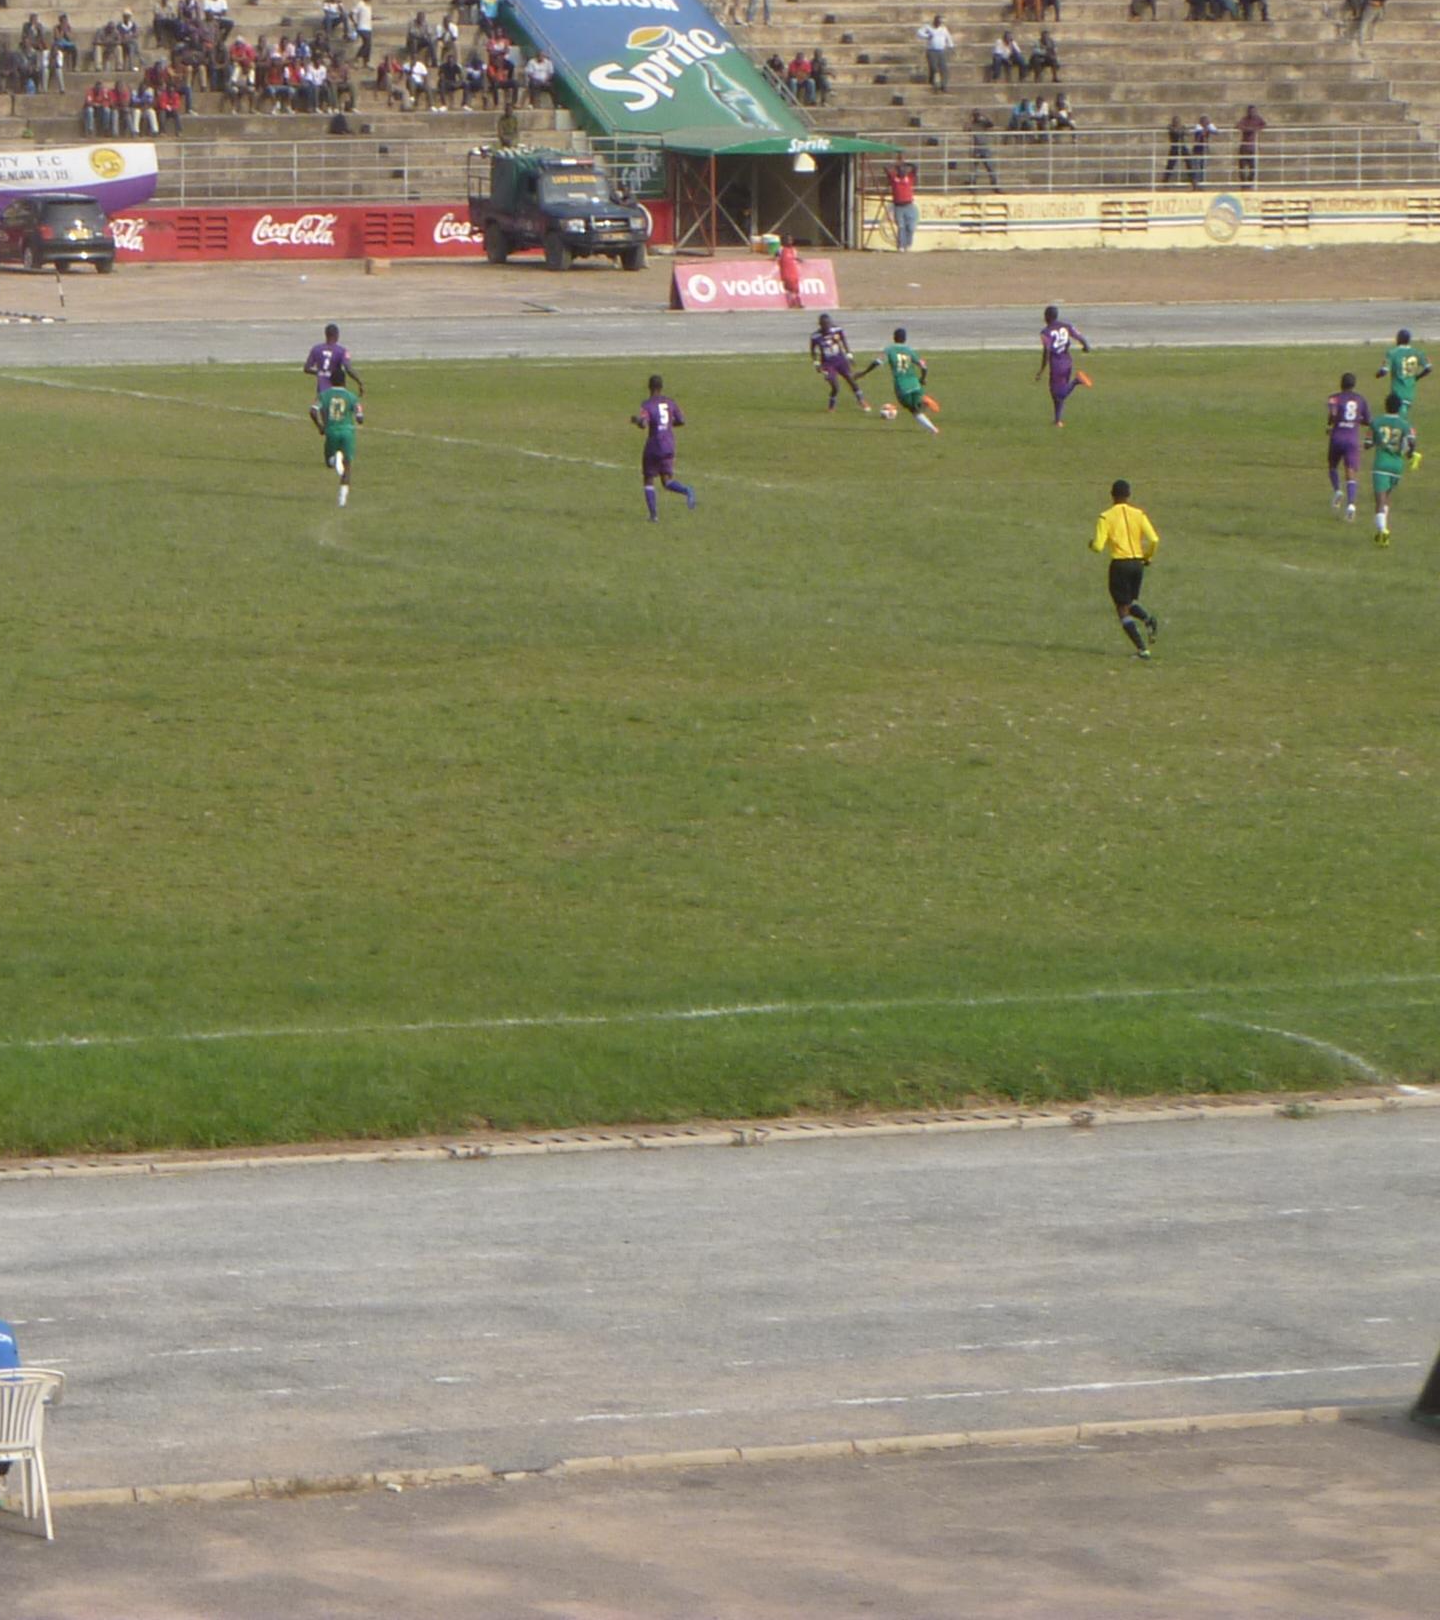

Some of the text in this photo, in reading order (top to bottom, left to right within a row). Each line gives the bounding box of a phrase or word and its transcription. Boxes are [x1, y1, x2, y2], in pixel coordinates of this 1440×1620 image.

[588, 28, 728, 112] Sprite
[251, 214, 337, 247] Coca-Cola
[722, 273, 826, 296] vodaom
[657, 402, 671, 426] 5
